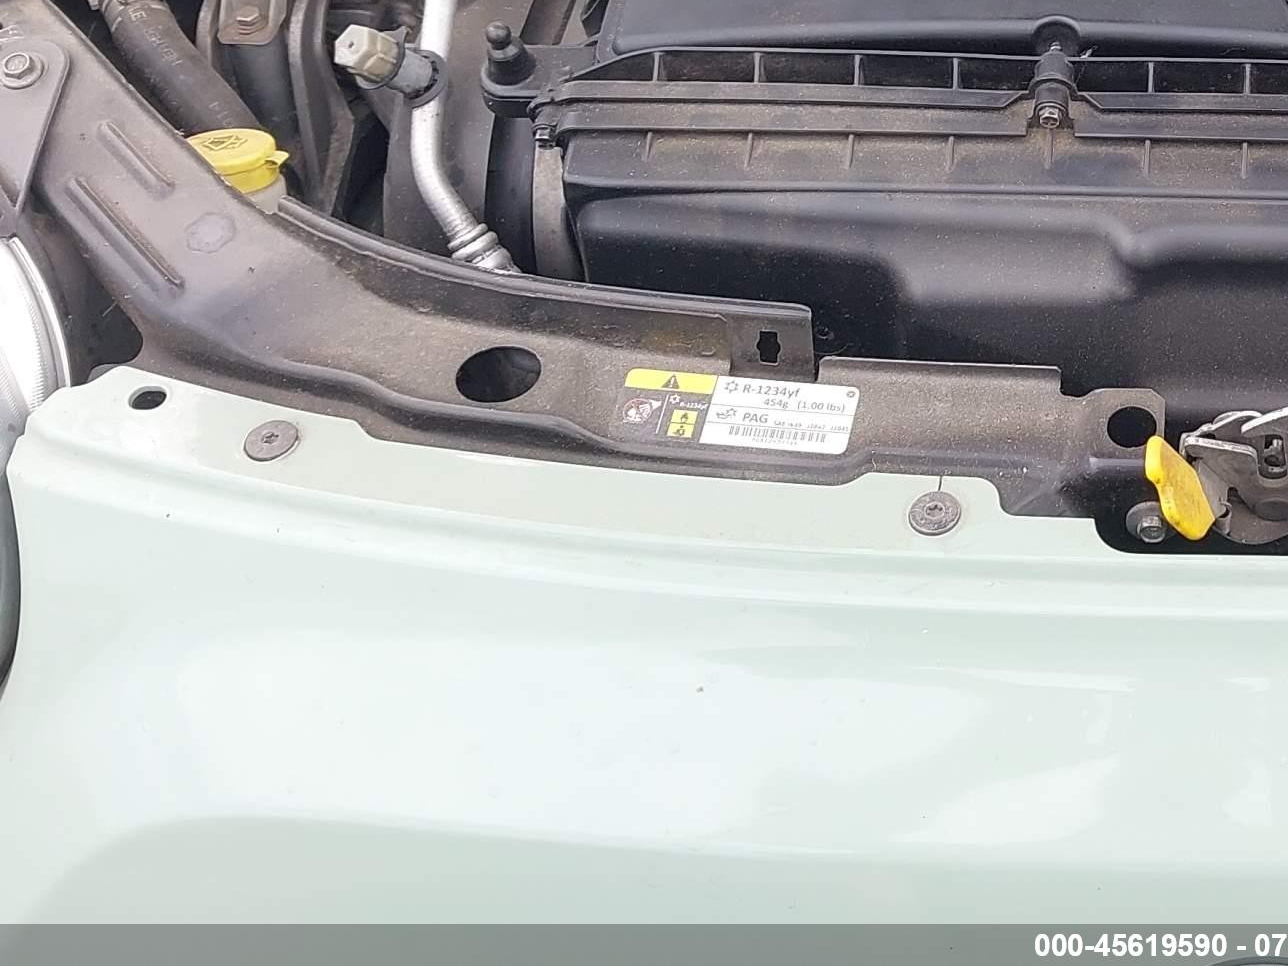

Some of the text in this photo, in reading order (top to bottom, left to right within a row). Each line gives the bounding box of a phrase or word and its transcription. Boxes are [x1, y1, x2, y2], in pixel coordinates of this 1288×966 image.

[742, 384, 800, 398] R-1234yf
[763, 398, 789, 410] 454g
[826, 401, 846, 413] lbs)
[742, 412, 768, 424] PAG
